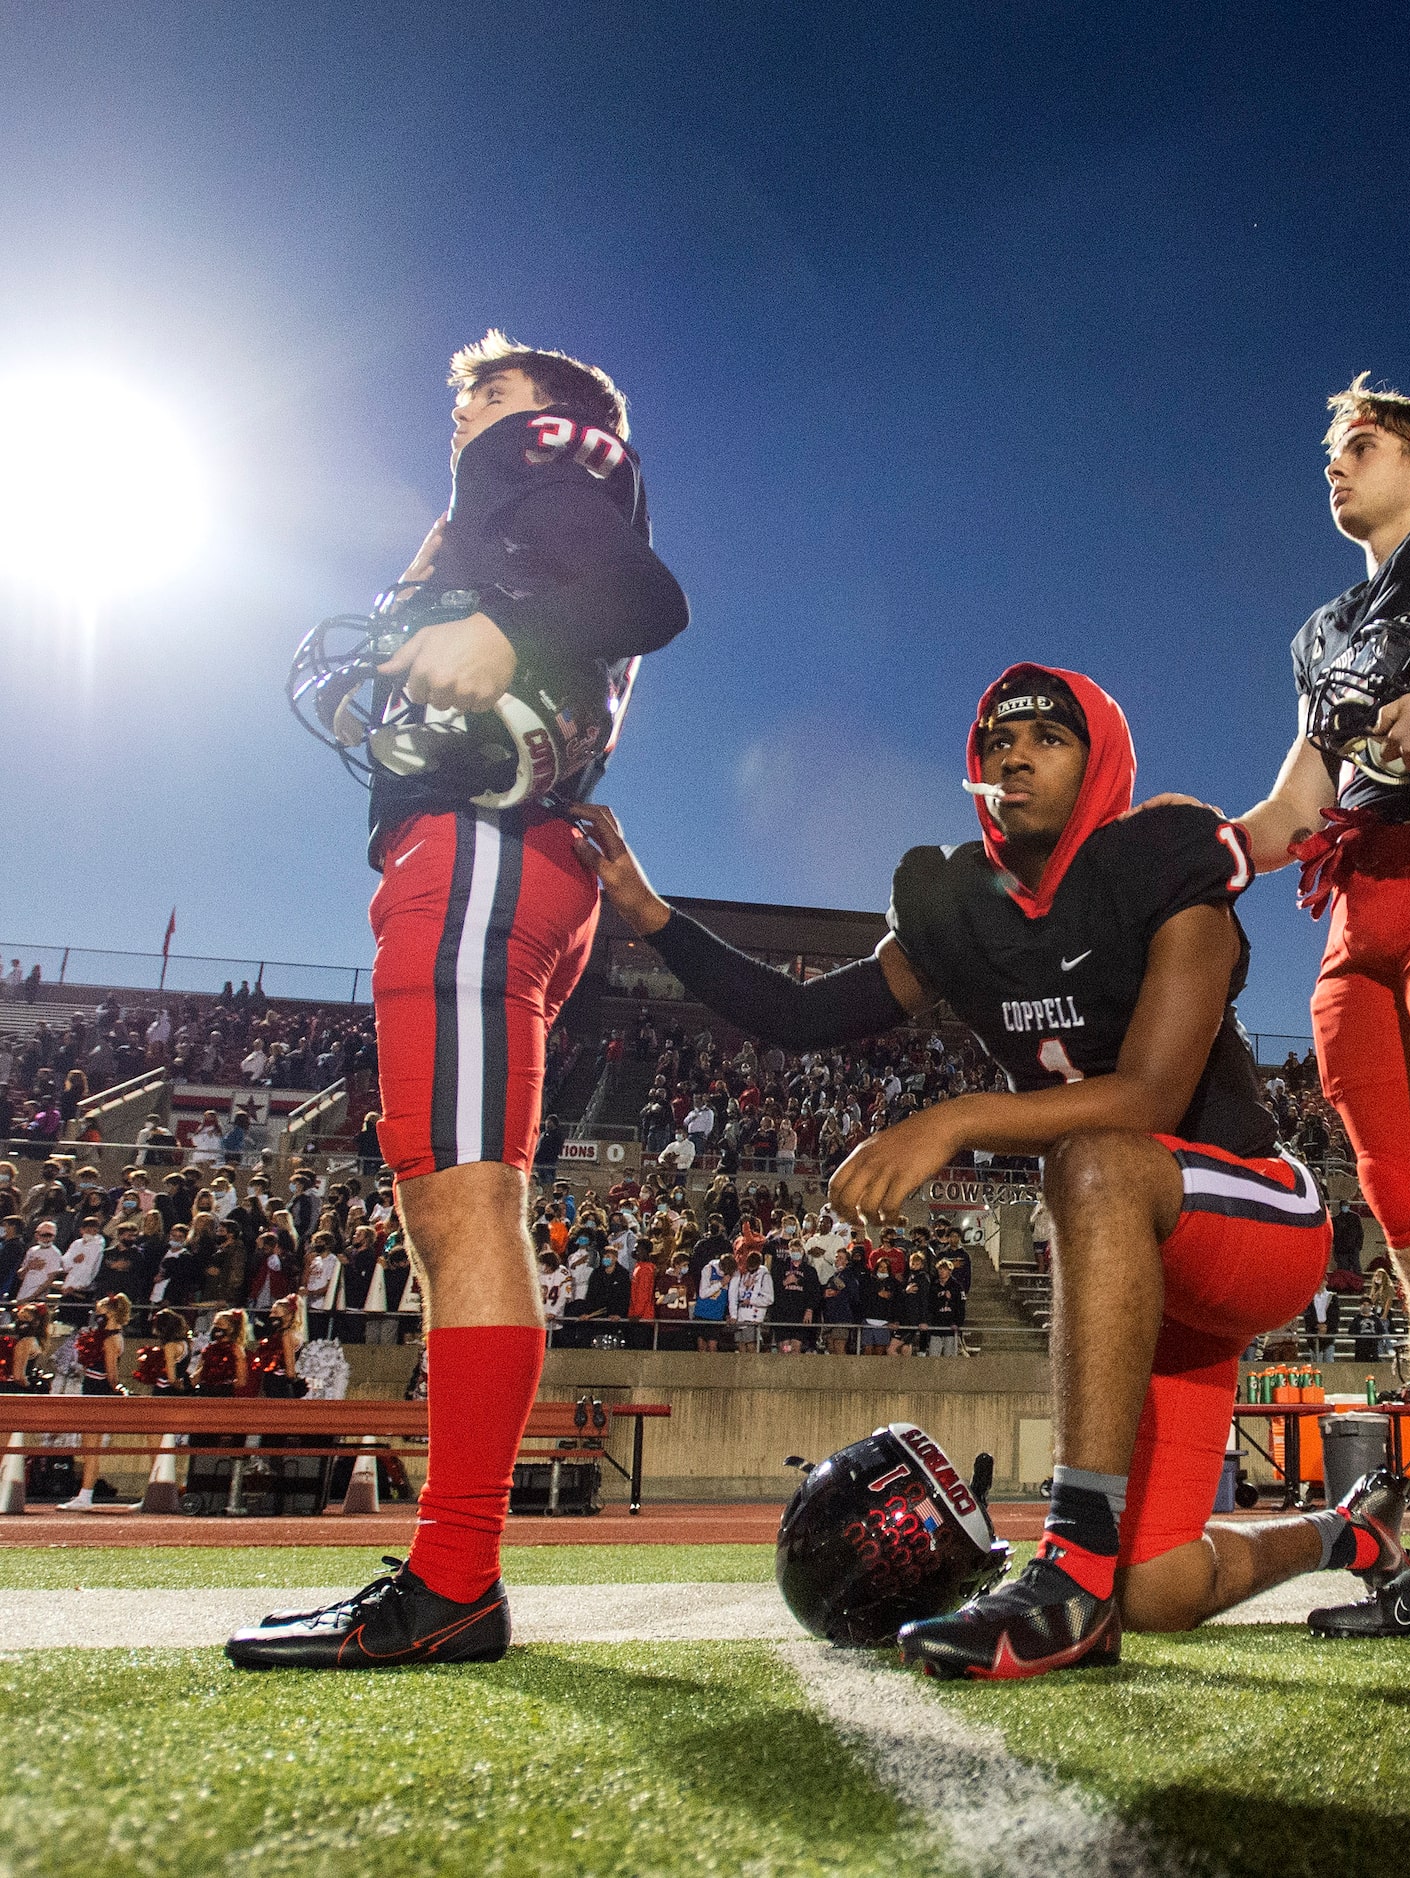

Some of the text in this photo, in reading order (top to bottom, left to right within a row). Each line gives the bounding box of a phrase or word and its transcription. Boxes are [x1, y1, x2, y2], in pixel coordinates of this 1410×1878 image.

[523, 413, 626, 480] 30
[998, 698, 1047, 713] ATTLE
[1215, 823, 1250, 891] 1
[1001, 996, 1085, 1032] COPPELL
[868, 1463, 911, 1492] 1
[900, 1429, 977, 1517] COWBOYS
